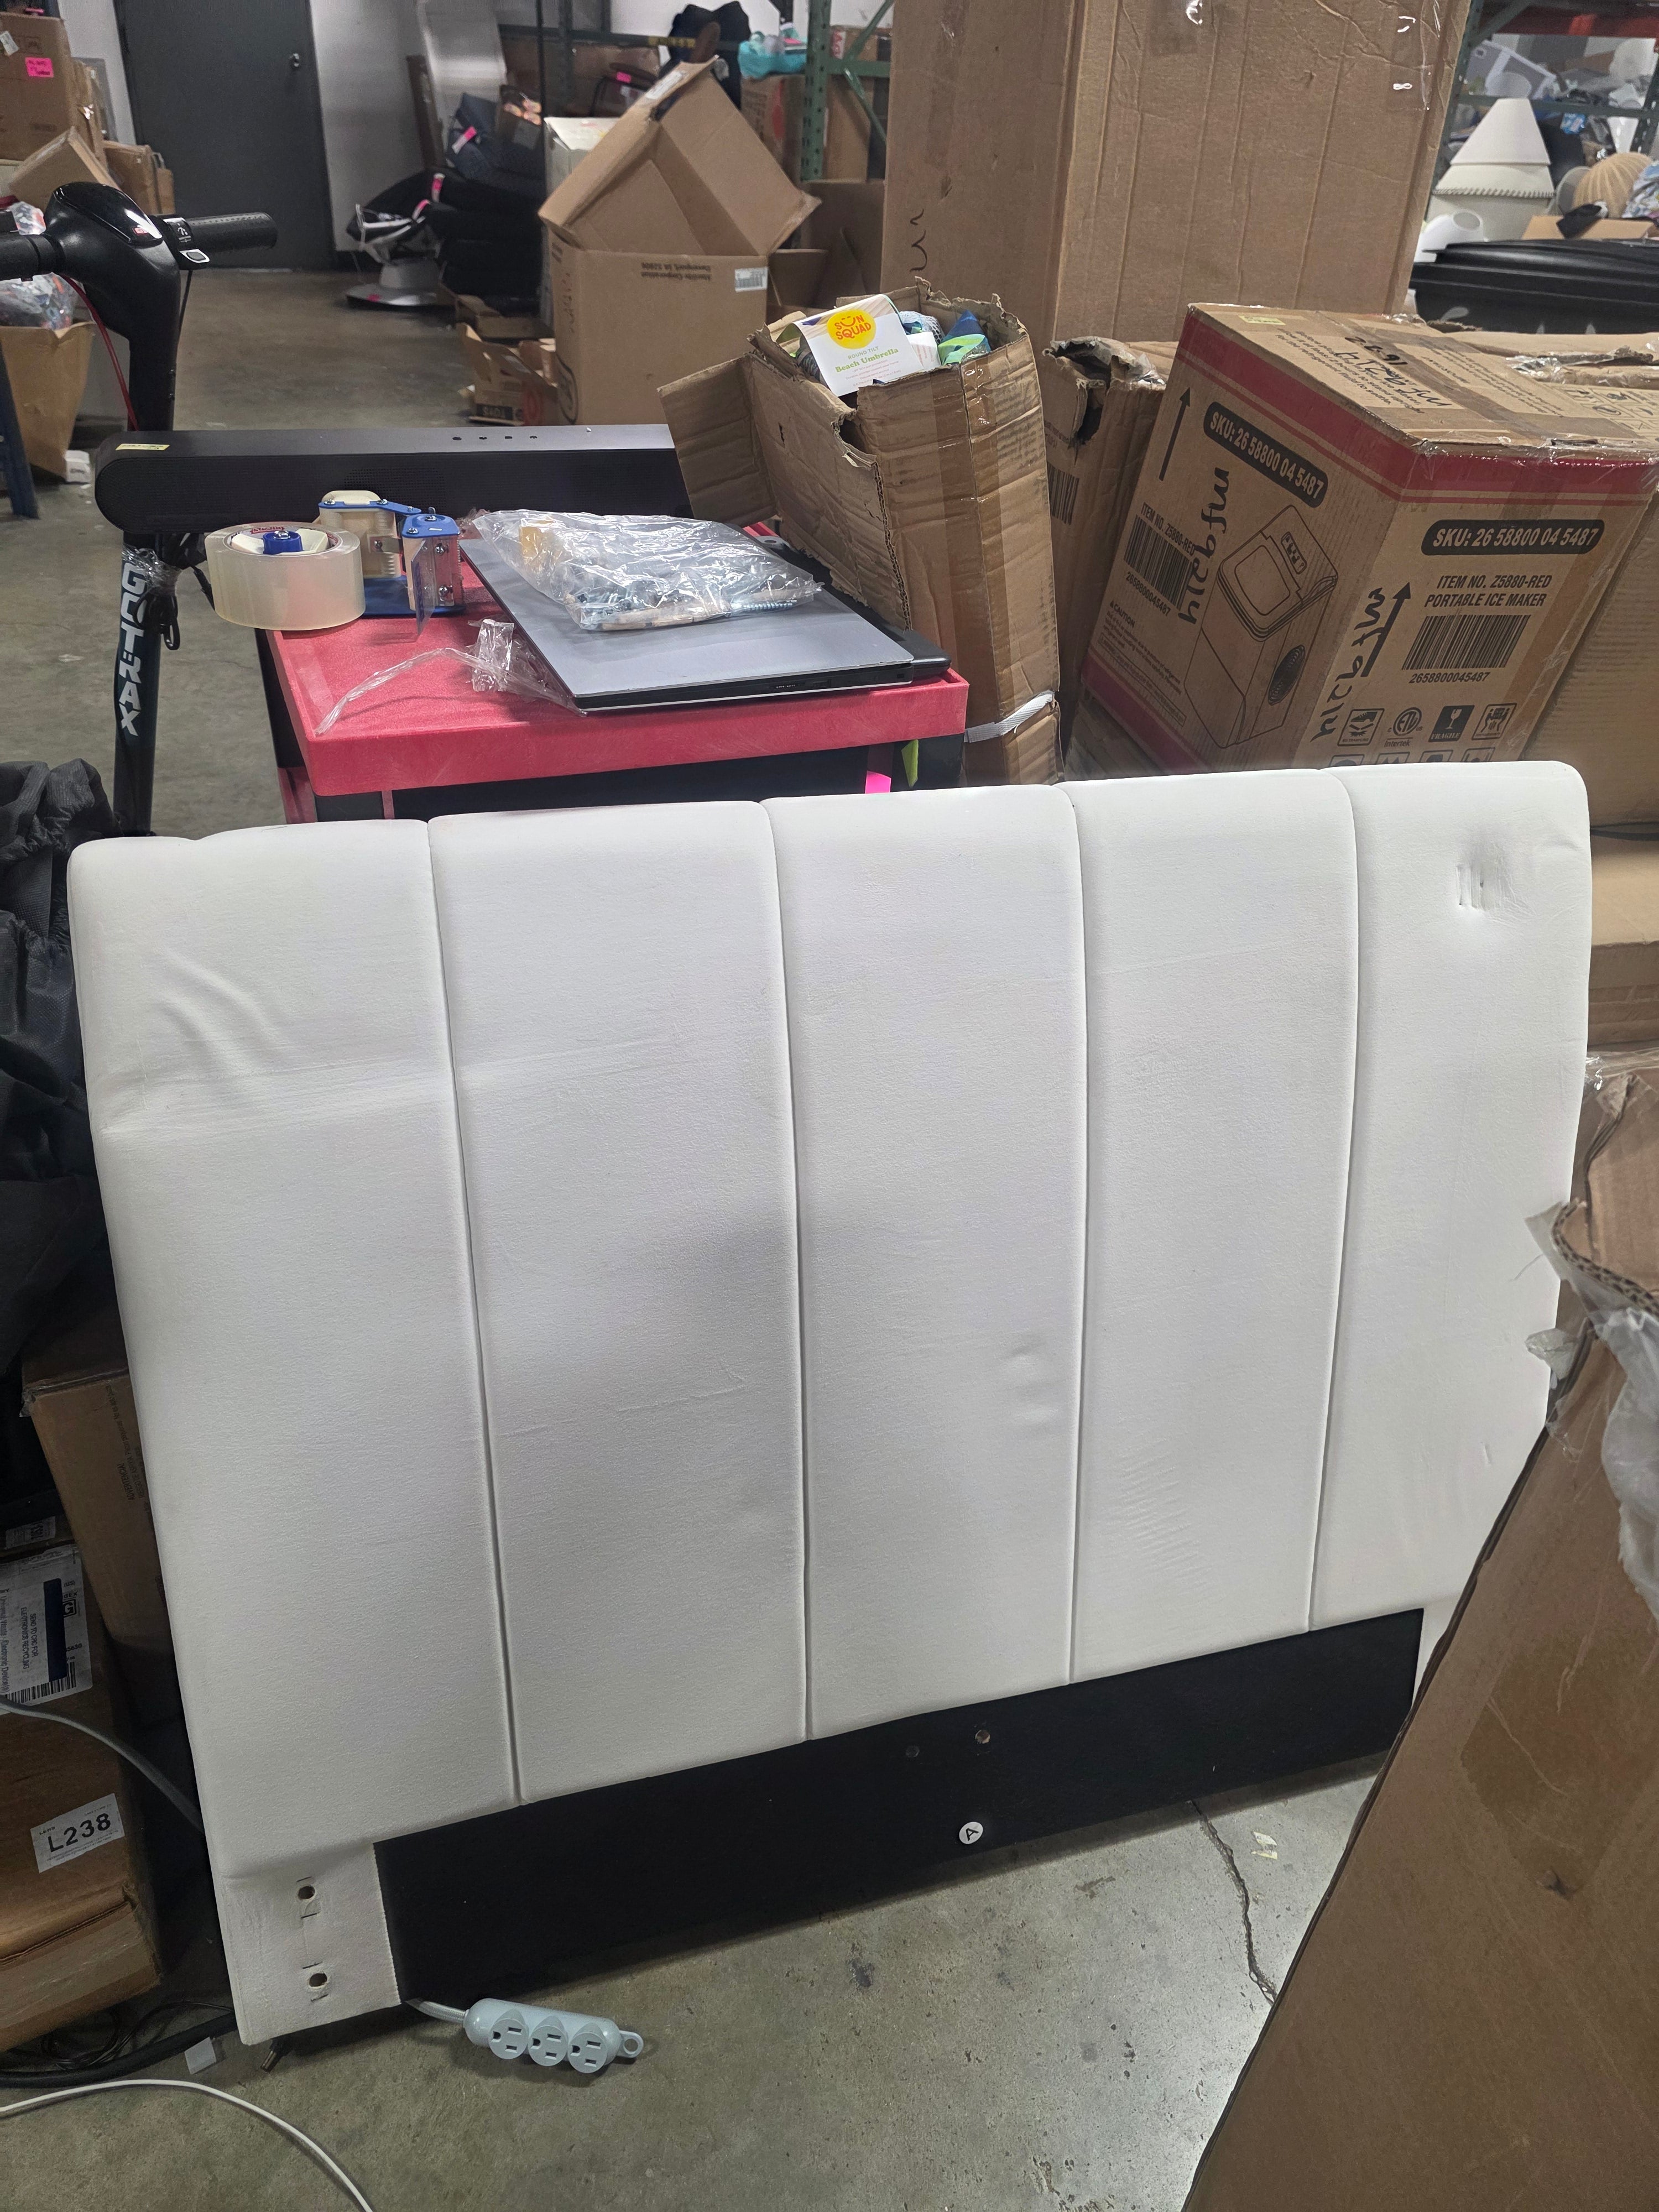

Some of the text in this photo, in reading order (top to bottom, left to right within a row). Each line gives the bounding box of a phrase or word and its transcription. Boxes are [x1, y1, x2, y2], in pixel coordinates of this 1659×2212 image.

[834, 315, 864, 330] SUN
[835, 322, 872, 340] SQUAD
[835, 348, 899, 373] Beach Umbrella
[848, 350, 867, 360] ROUND
[1210, 411, 1324, 499] SKU: 26 58800 04 5487
[1141, 502, 1195, 556] ITEM NO. Z5880-RED
[1433, 528, 1599, 547] SKU: 26 58800 04 5487
[1437, 575, 1552, 589] ITEM NO. Z5880-RED
[1126, 571, 1171, 616] 2658800045487
[1424, 593, 1547, 608] PORTABLE ICE MAKER
[1114, 603, 1135, 628] CAUTION
[1408, 672, 1491, 684] 2658800045487
[1384, 739, 1411, 748] Intertek
[1431, 732, 1460, 740] FRAGILE
[117, 1463, 135, 1501] ADVERTENCIA!
[1, 1640, 9, 1666] Electronic
[22, 1641, 30, 1670] RECYCLING
[48, 1813, 111, 1853] L238
[966, 1828, 979, 1841] A
